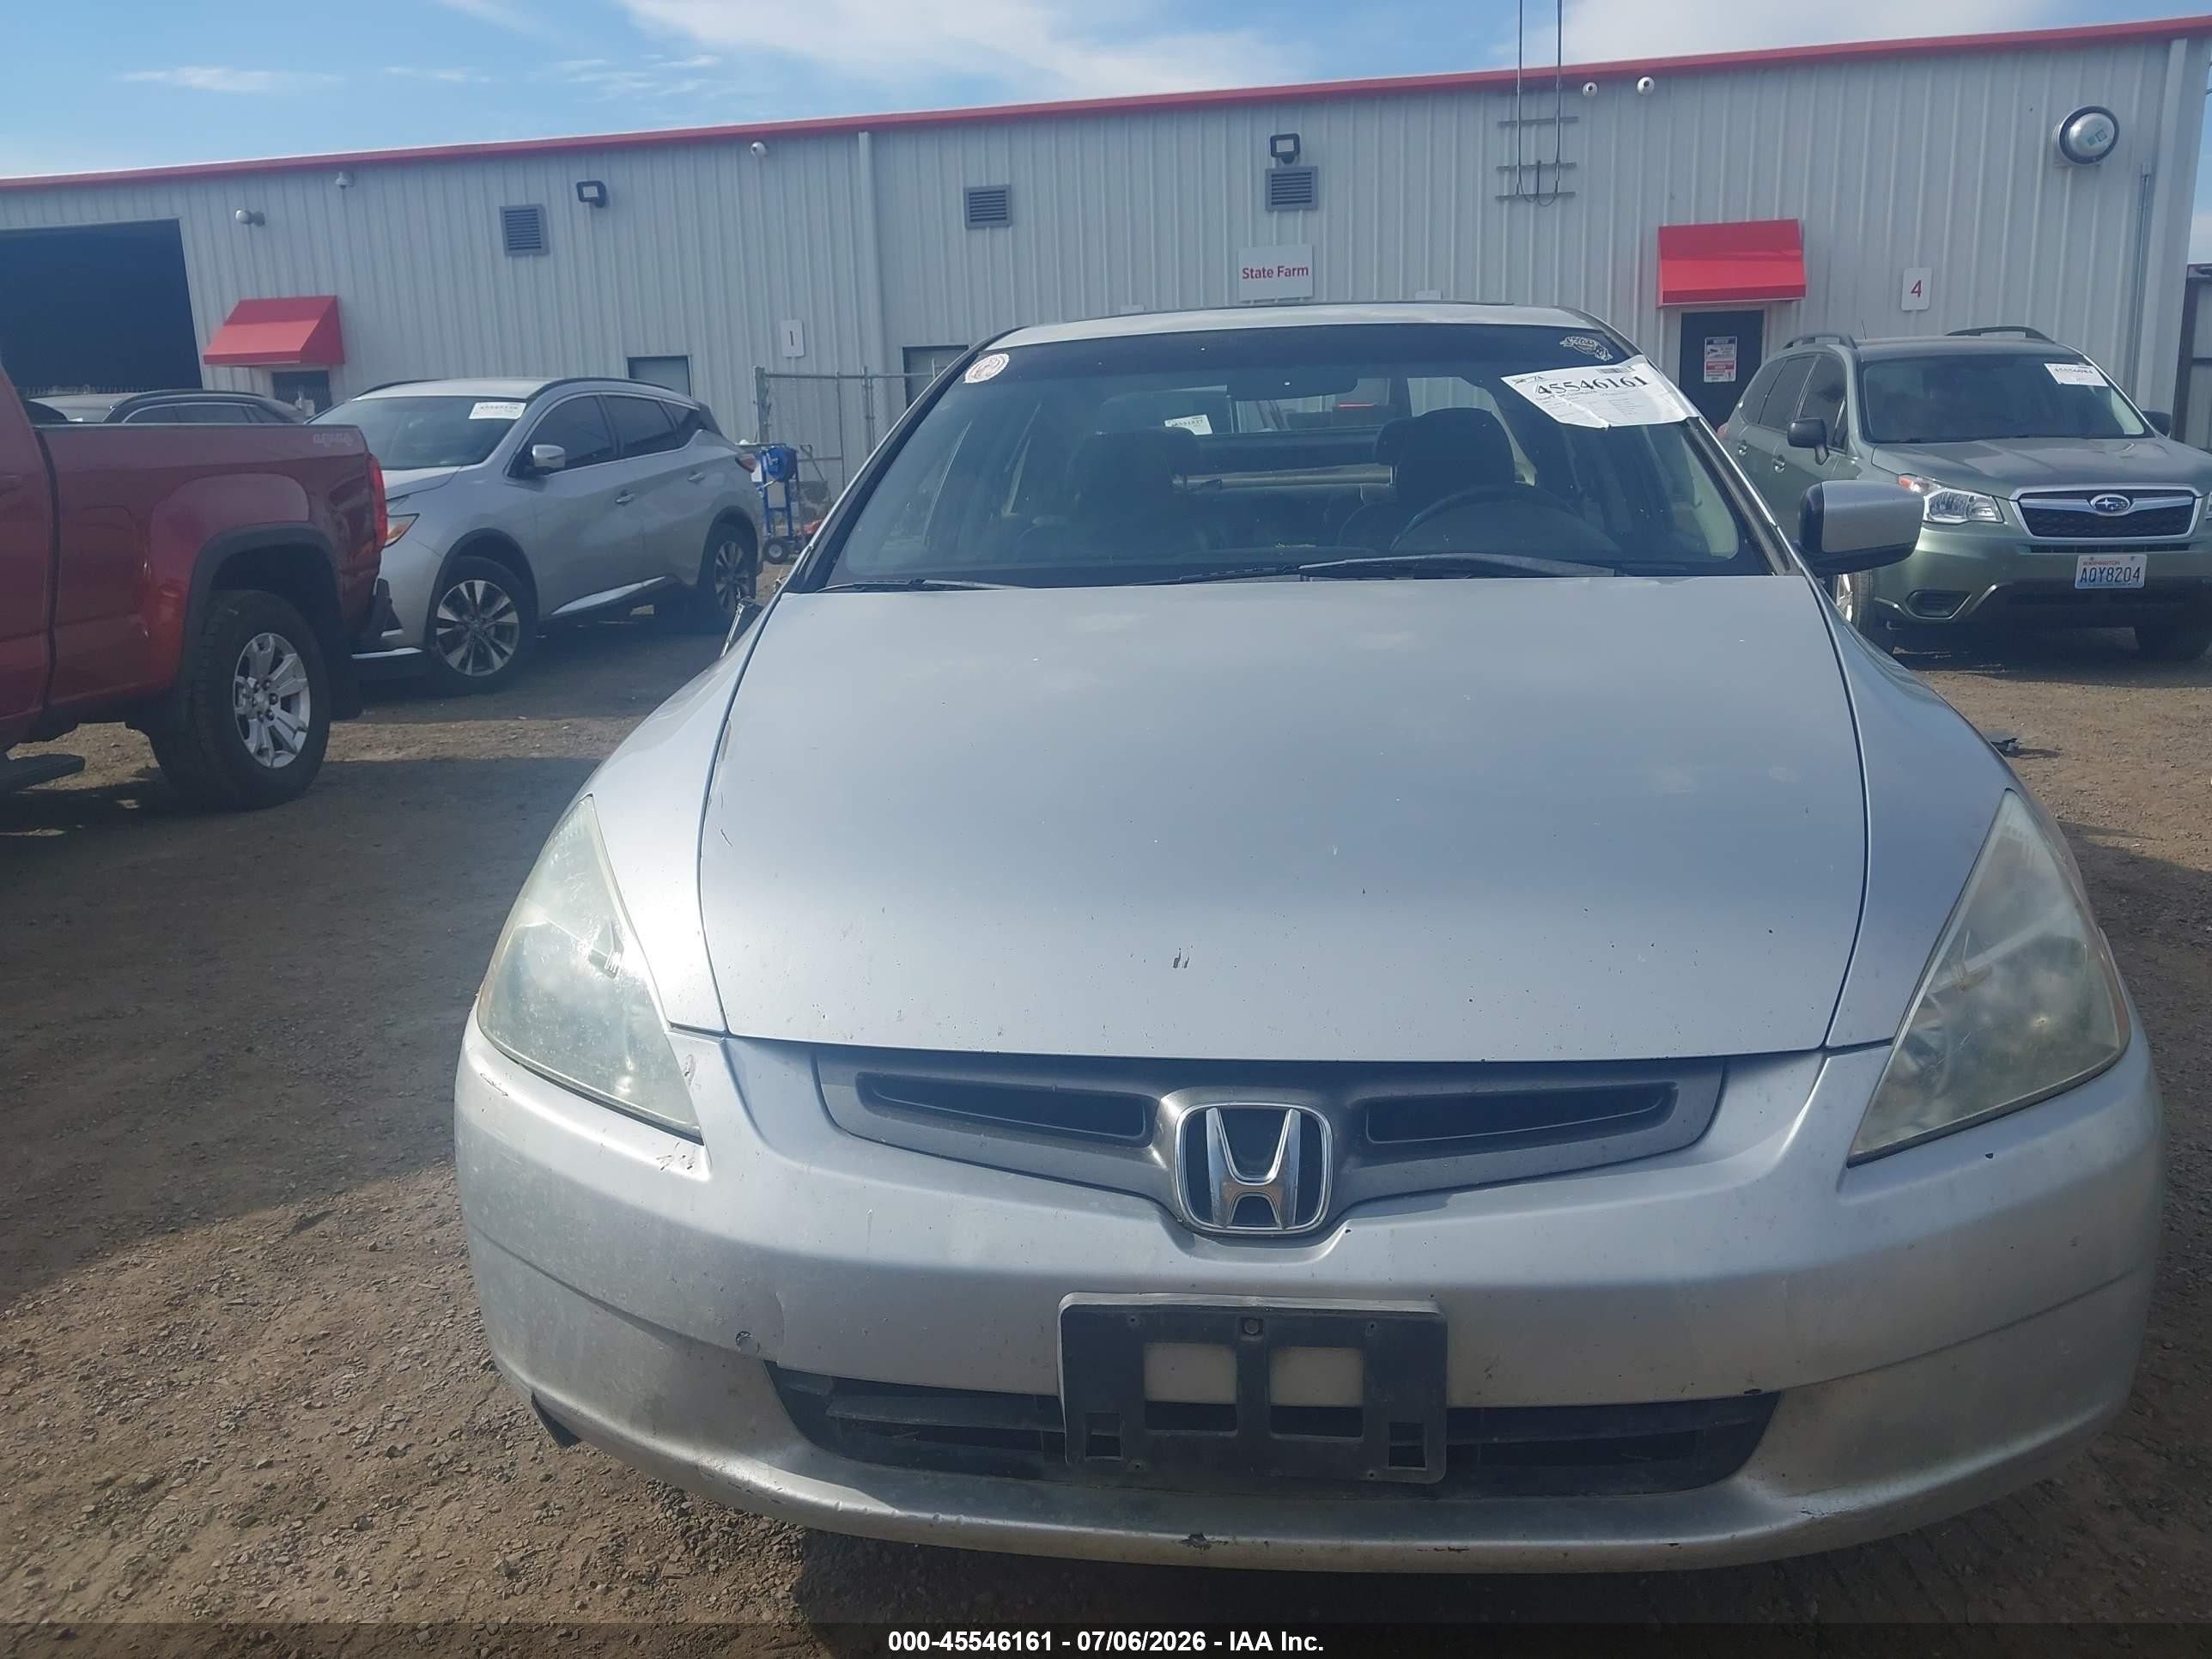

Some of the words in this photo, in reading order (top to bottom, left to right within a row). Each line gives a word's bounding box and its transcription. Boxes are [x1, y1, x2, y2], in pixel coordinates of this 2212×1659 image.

[1242, 267, 1274, 279] State
[1277, 264, 1309, 277] Farm
[1910, 279, 1922, 298] 4
[1536, 375, 1649, 395] 45546161
[2080, 567, 2141, 583] AQY8204
